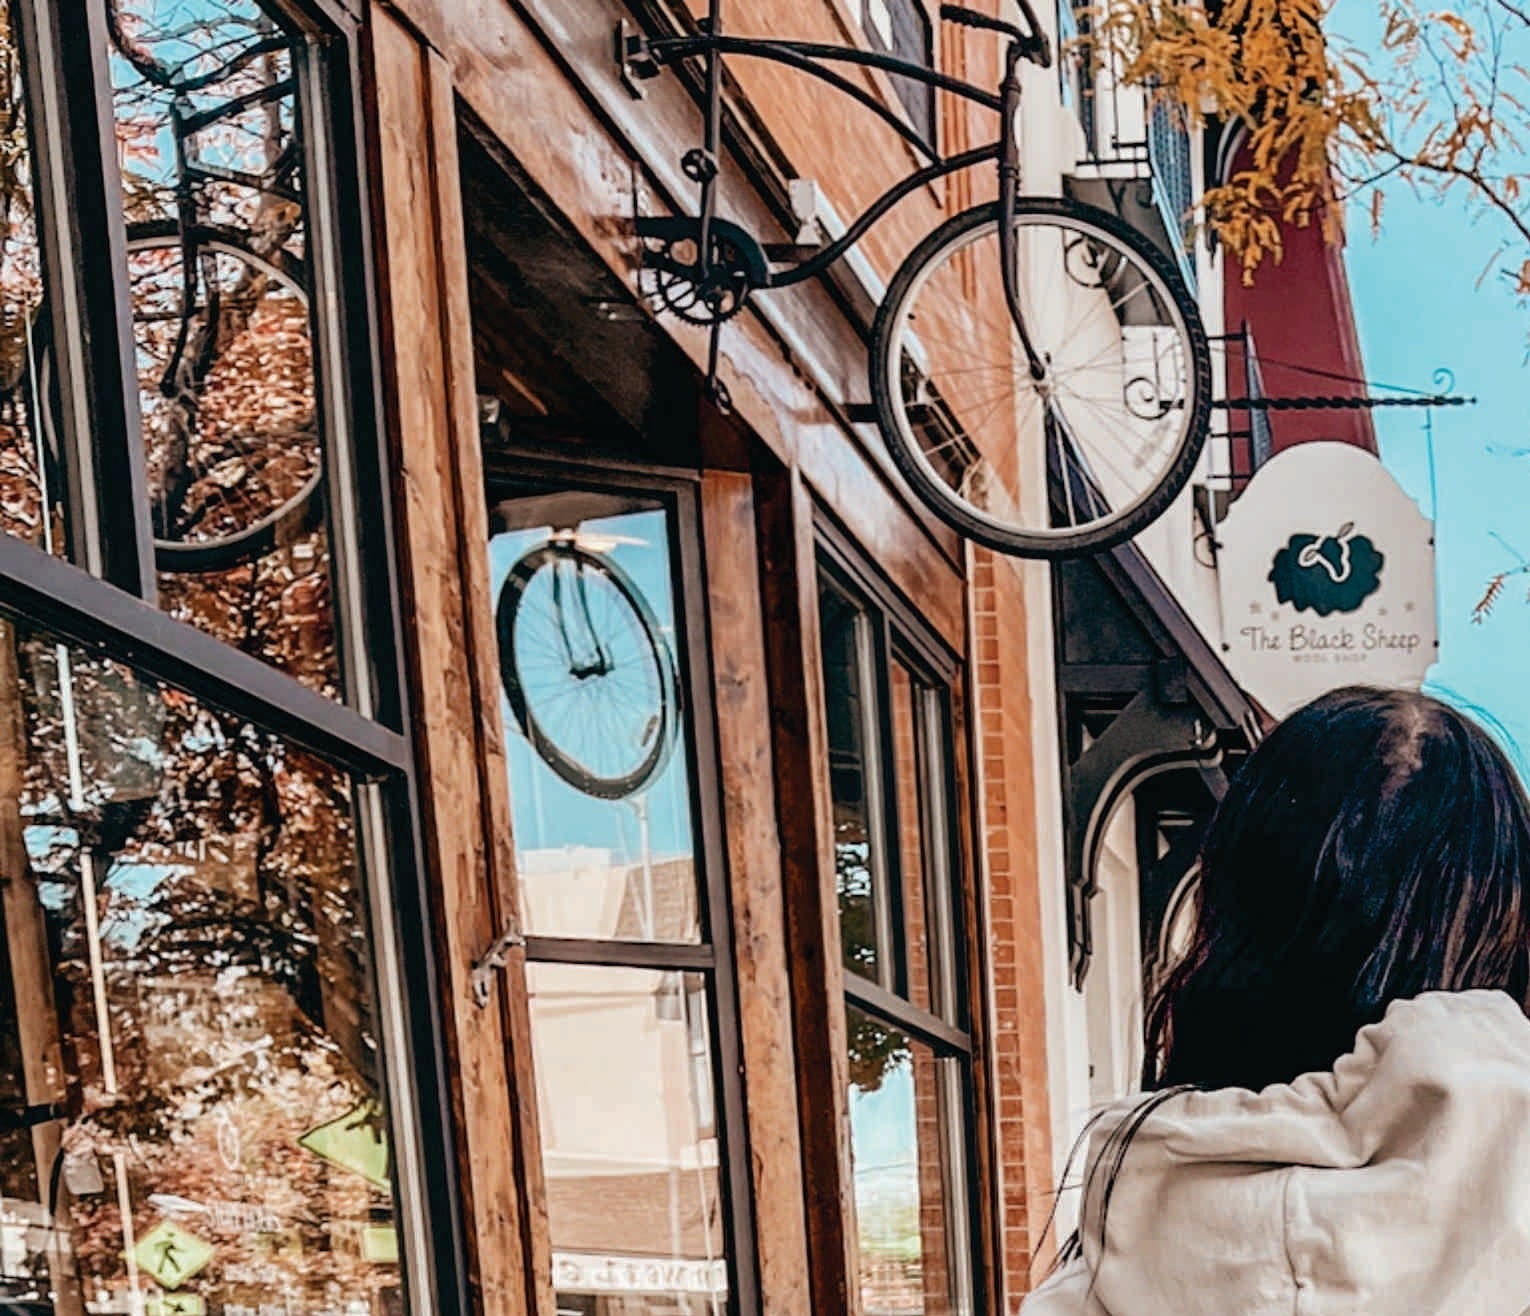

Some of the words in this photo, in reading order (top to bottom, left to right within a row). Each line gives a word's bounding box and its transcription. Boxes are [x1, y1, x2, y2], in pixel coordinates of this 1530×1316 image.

[1240, 626, 1280, 650] The
[1290, 623, 1354, 651] Black
[1362, 623, 1420, 654] Sheep
